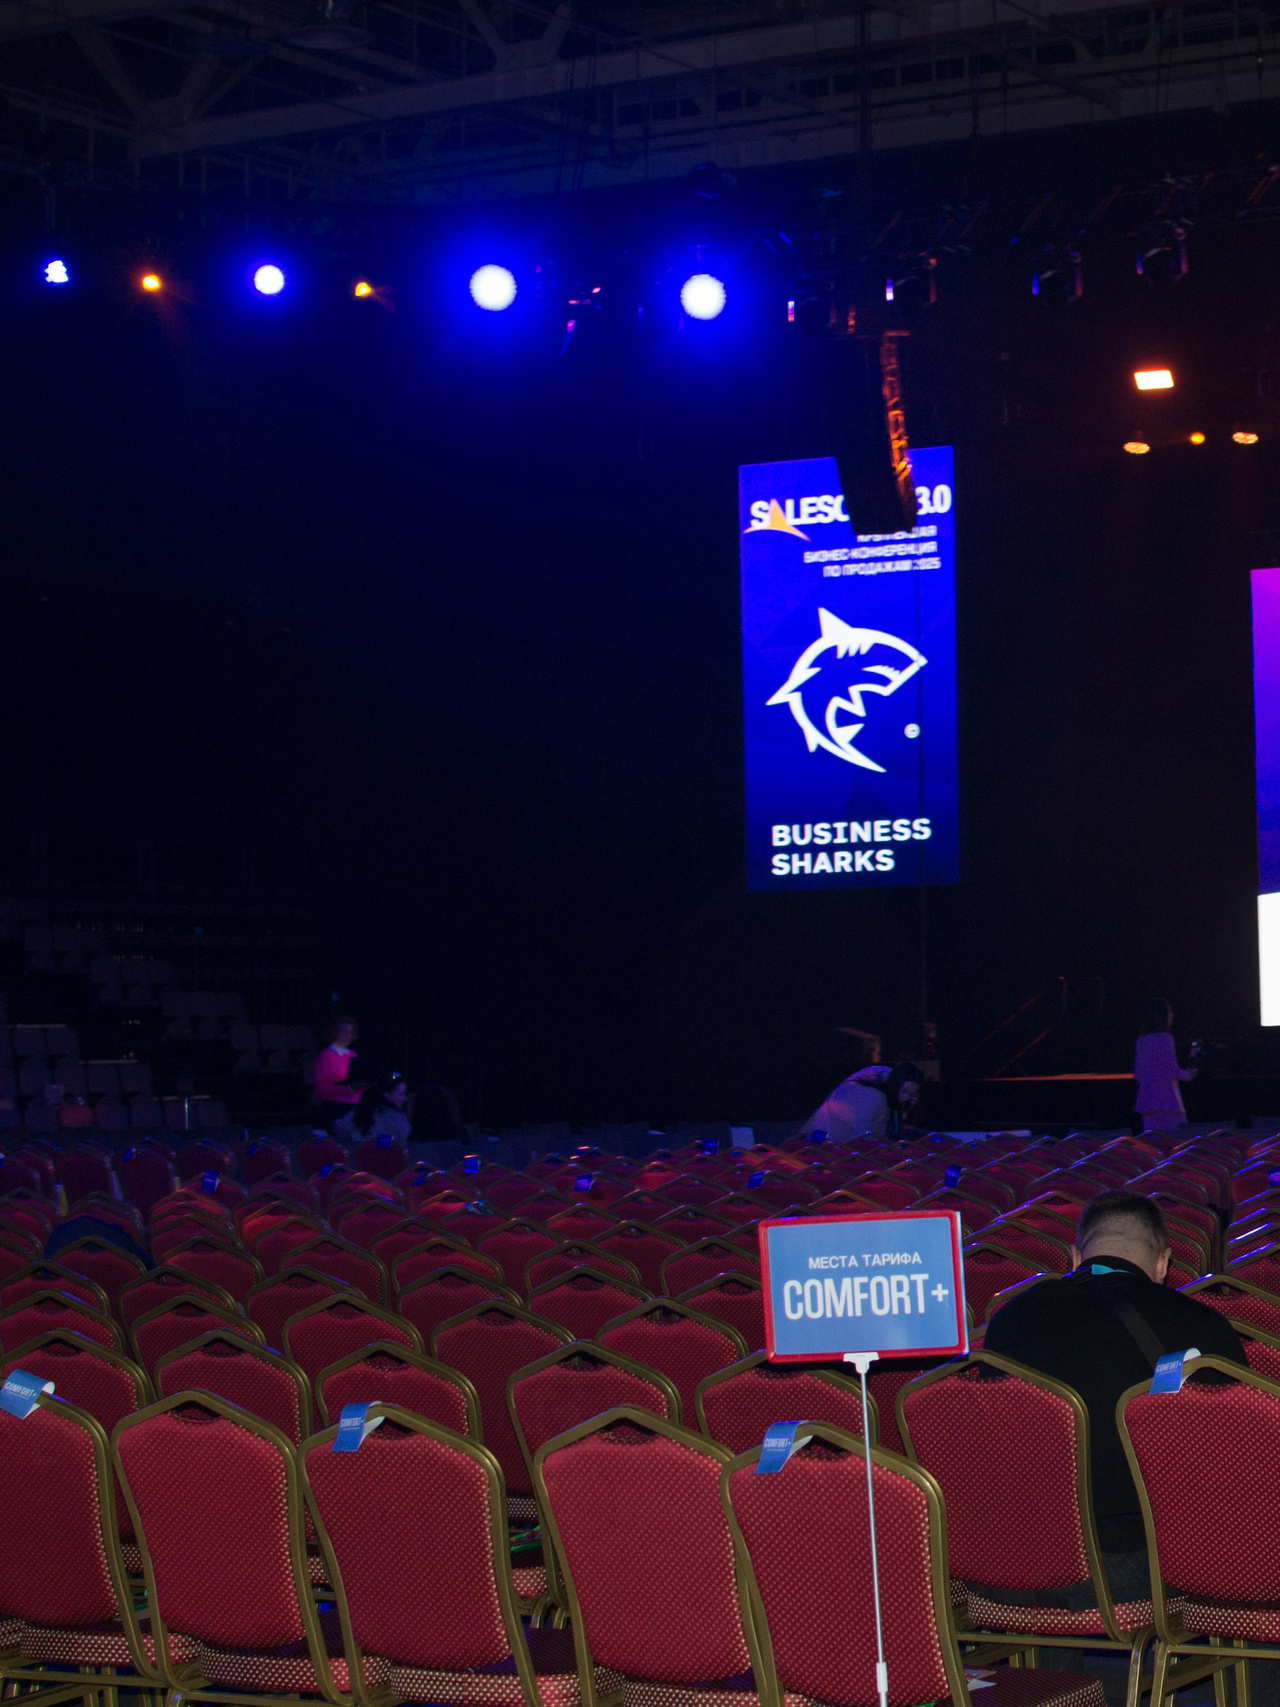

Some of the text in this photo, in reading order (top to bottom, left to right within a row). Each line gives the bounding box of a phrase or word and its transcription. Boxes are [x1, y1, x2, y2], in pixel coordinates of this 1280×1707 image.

[750, 484, 952, 529] SALESC 3.0
[823, 565, 841, 578] ПО
[842, 559, 912, 576] ПРОДАЖАМ
[771, 817, 932, 847] BUSINESS
[771, 849, 895, 876] SHARKS
[808, 1252, 922, 1270] МЕСТА ТАРИФА
[783, 1273, 949, 1320] COMFORT+
